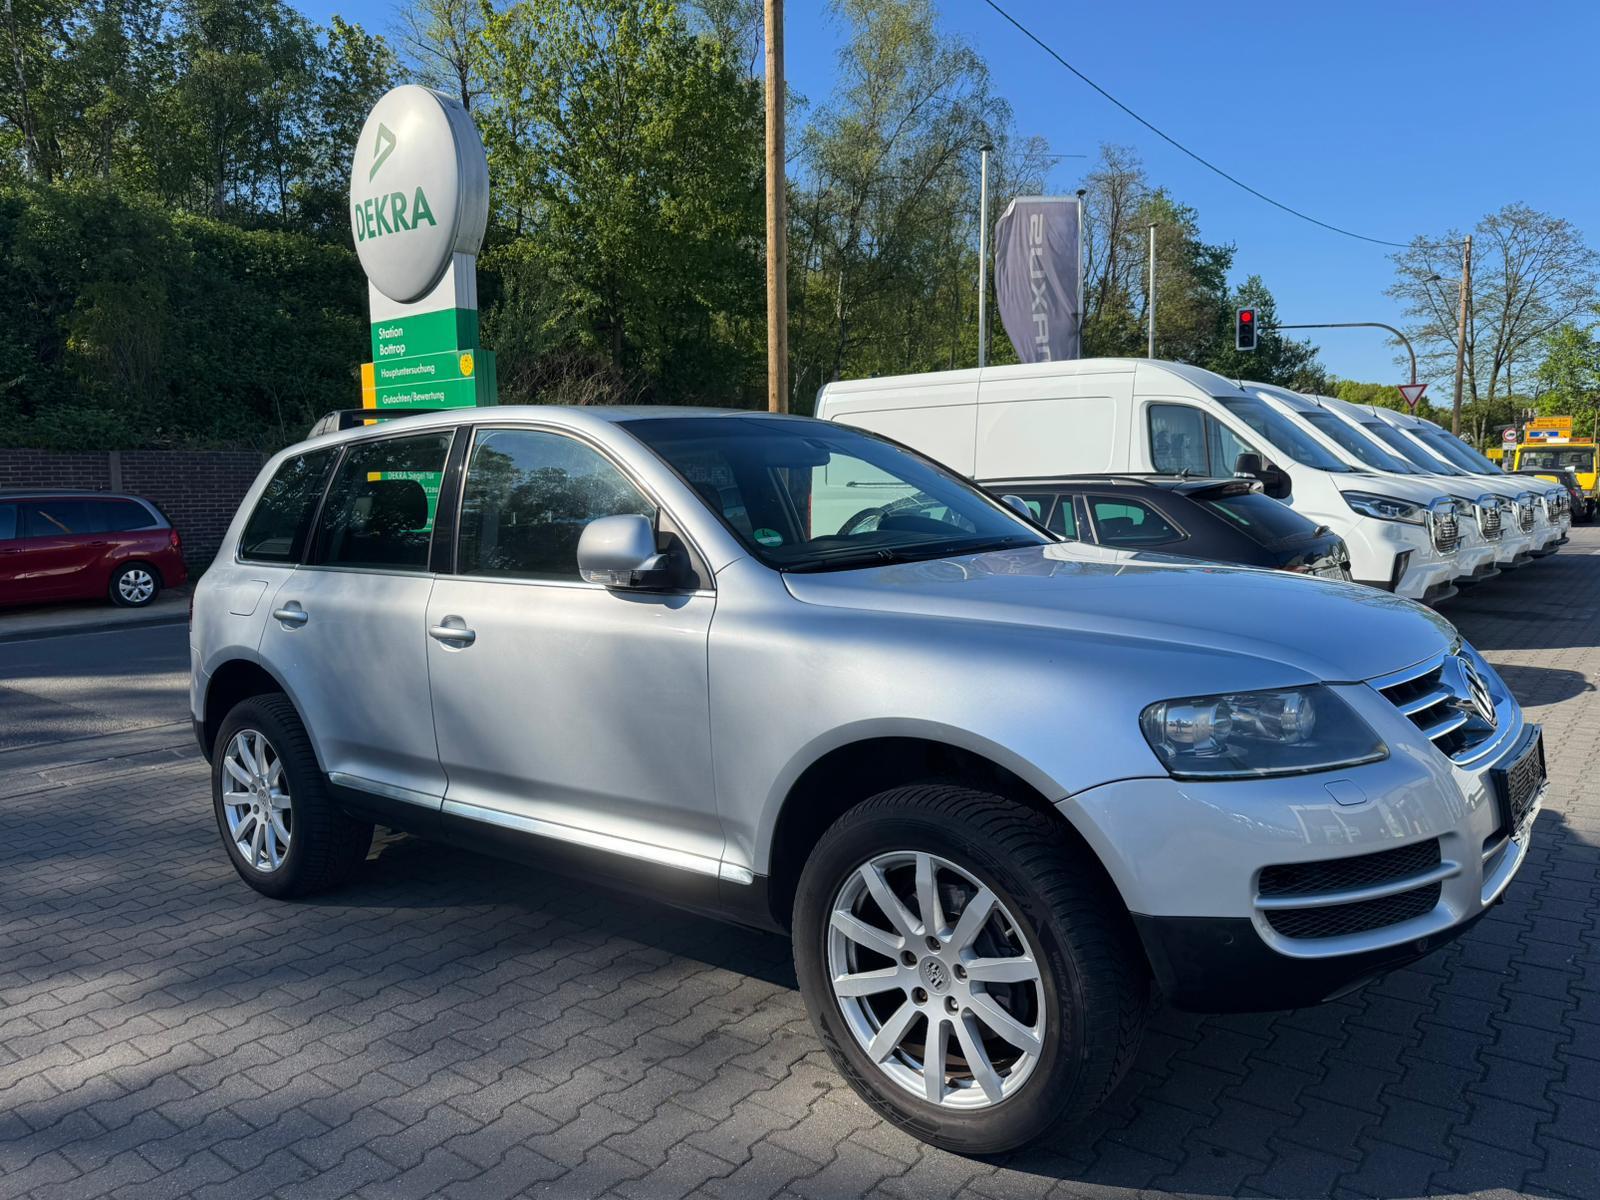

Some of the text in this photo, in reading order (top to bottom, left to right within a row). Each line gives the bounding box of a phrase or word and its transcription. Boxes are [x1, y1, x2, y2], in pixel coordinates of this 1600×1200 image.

[355, 186, 437, 242] DEKRA
[378, 326, 404, 340] Station
[379, 343, 406, 356] Bottrop
[381, 364, 435, 379] Hauptuntersuchung
[382, 391, 445, 404] Gutachten/Bewertung
[387, 471, 407, 480] DEKRA
